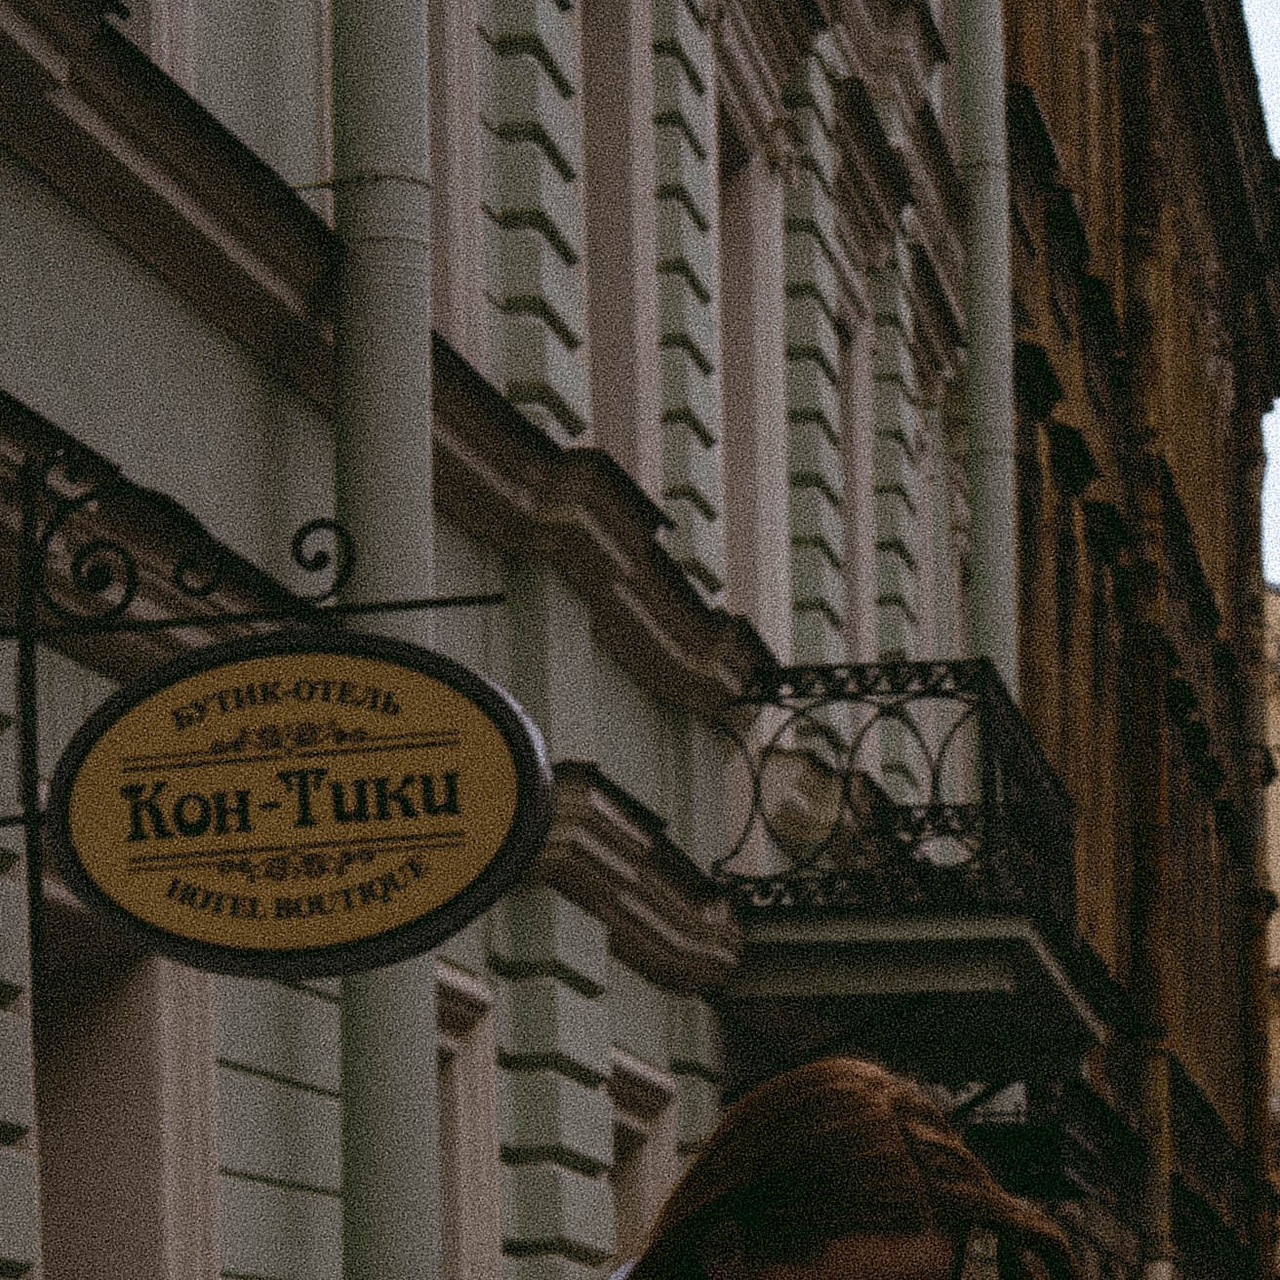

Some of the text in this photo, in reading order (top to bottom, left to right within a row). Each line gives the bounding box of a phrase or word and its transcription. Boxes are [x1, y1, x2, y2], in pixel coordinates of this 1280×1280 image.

[171, 679, 402, 731] БУТИК-ОТЕЛЬ
[120, 768, 462, 842] Кон-Тики
[166, 857, 426, 920] HOTEL BOUTIQUE
